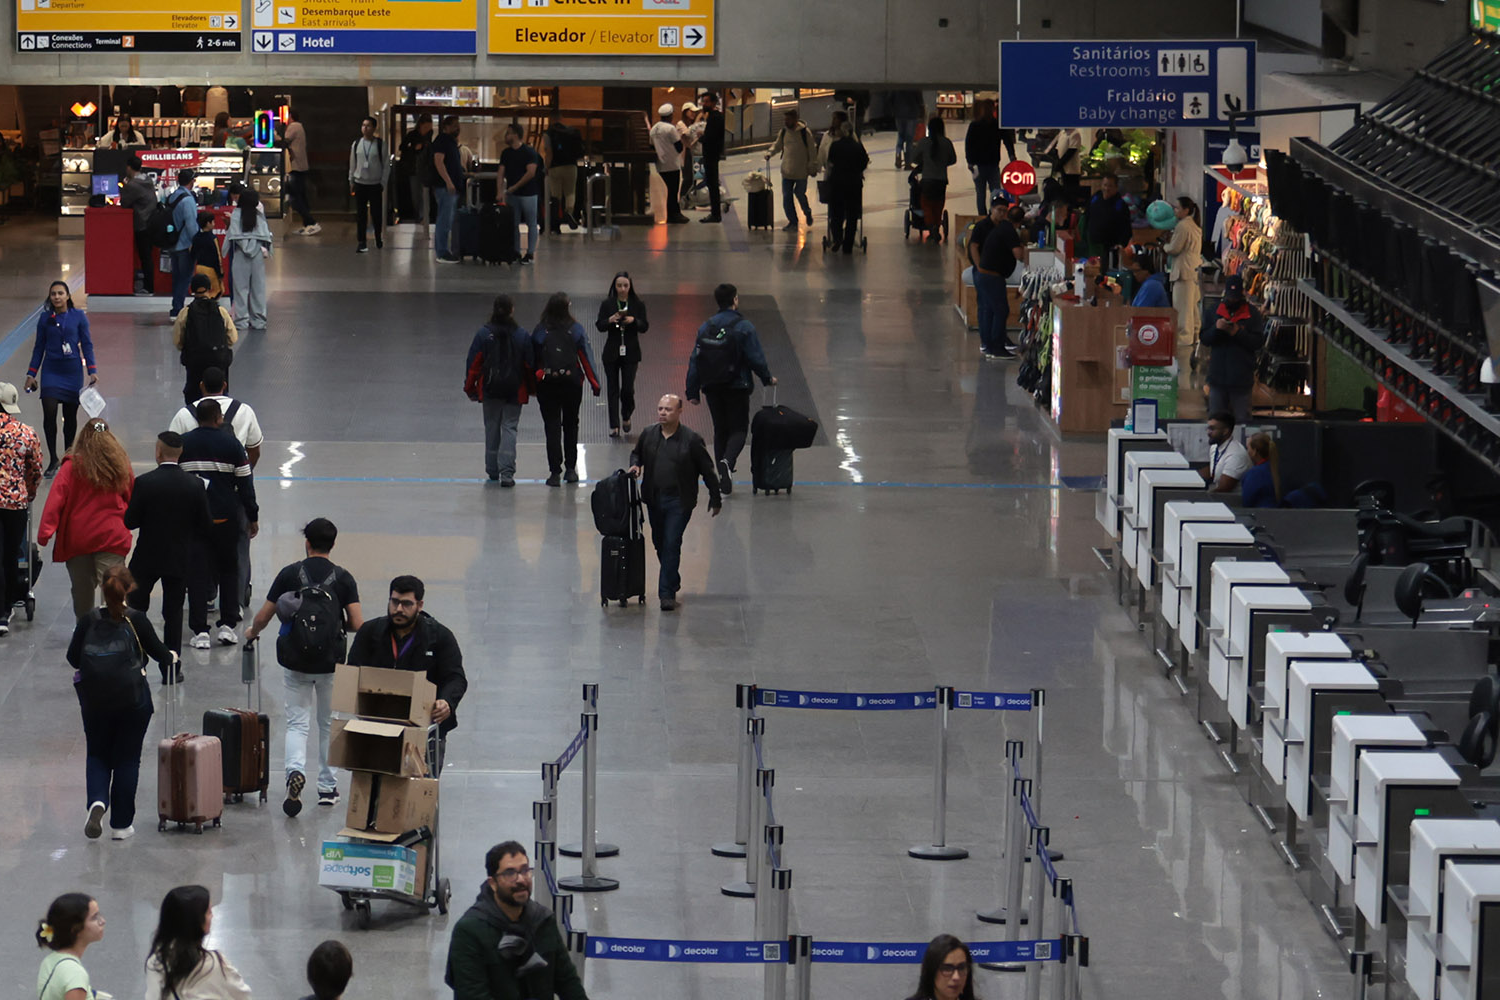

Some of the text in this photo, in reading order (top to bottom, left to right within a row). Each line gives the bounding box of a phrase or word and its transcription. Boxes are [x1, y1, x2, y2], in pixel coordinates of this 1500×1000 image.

[302, 8, 390, 18] Desembarque Leste
[302, 18, 356, 26] East arrivals
[515, 28, 586, 42] Elevador
[600, 31, 654, 43] Elevator
[125, 37, 131, 46] 2
[303, 37, 334, 48] Hotel
[1072, 47, 1150, 60] Sanitários
[1069, 65, 1150, 77] Restrooms
[1108, 89, 1176, 102] Fraldário
[1079, 107, 1176, 123] Baby change
[1002, 171, 1034, 185] FOM
[869, 697, 895, 705] decolar
[325, 850, 341, 858] VIP
[324, 864, 371, 876] Softpaper
[611, 944, 645, 952] decolar
[882, 949, 917, 957] decolar
